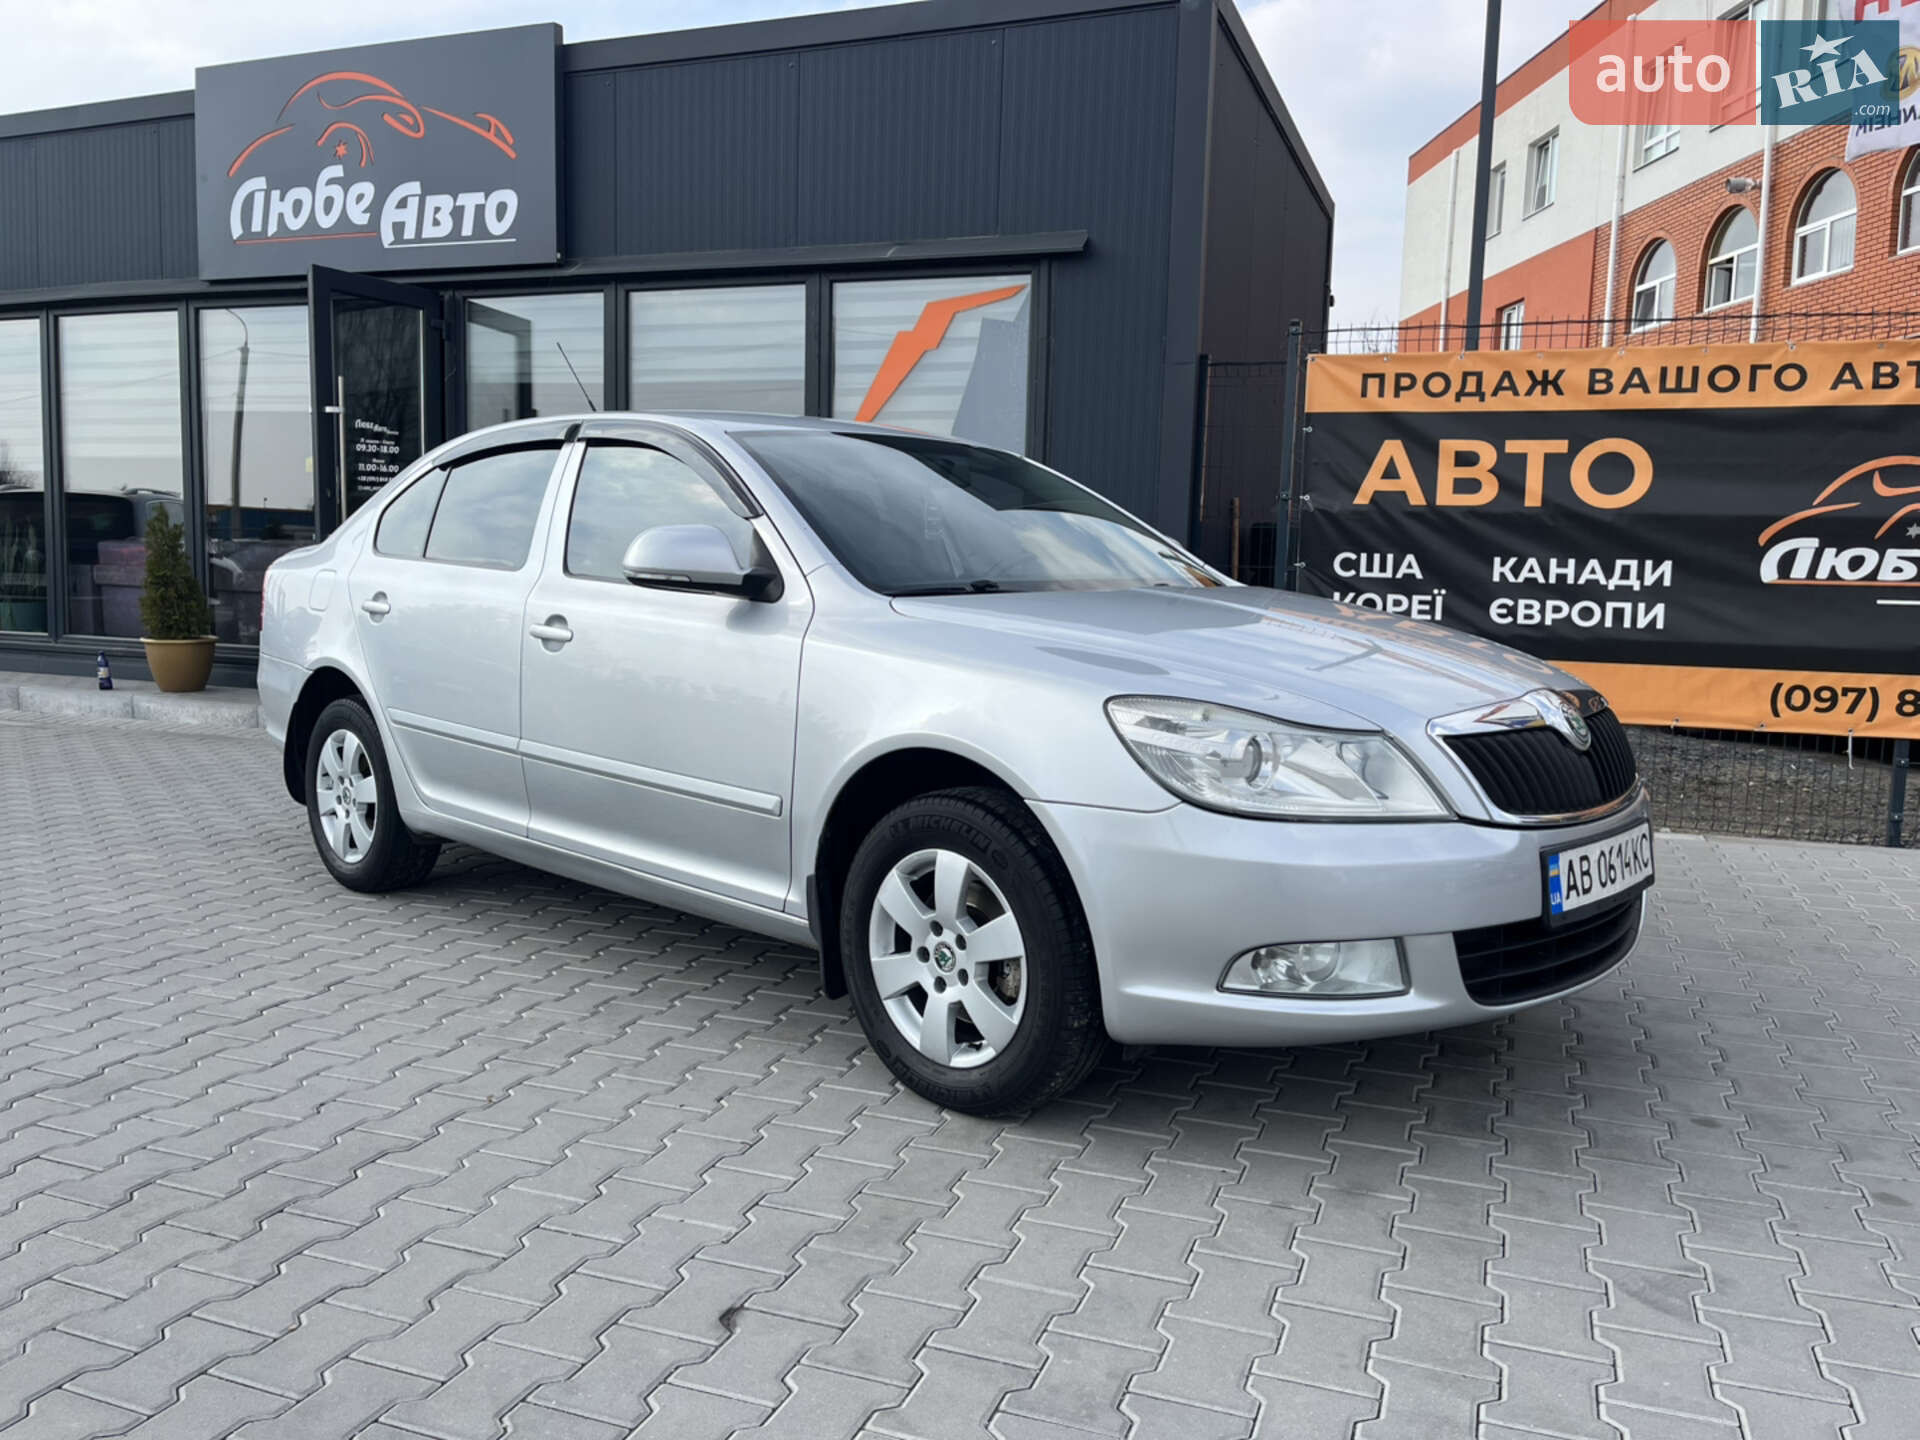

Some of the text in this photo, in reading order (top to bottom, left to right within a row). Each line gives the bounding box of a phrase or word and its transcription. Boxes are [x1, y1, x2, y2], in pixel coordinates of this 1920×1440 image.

[229, 164, 376, 241] Любе
[1360, 368, 1566, 402] ПРОДАЖ
[1587, 362, 1808, 395] ВАШОГО
[1352, 437, 1654, 509] АВТО
[1332, 551, 1424, 580] США
[1492, 556, 1673, 589] КАНАДИ
[1489, 597, 1667, 630] ЄВРОПИ
[1770, 682, 1920, 723] (097) 8
[1565, 854, 1593, 900] AB
